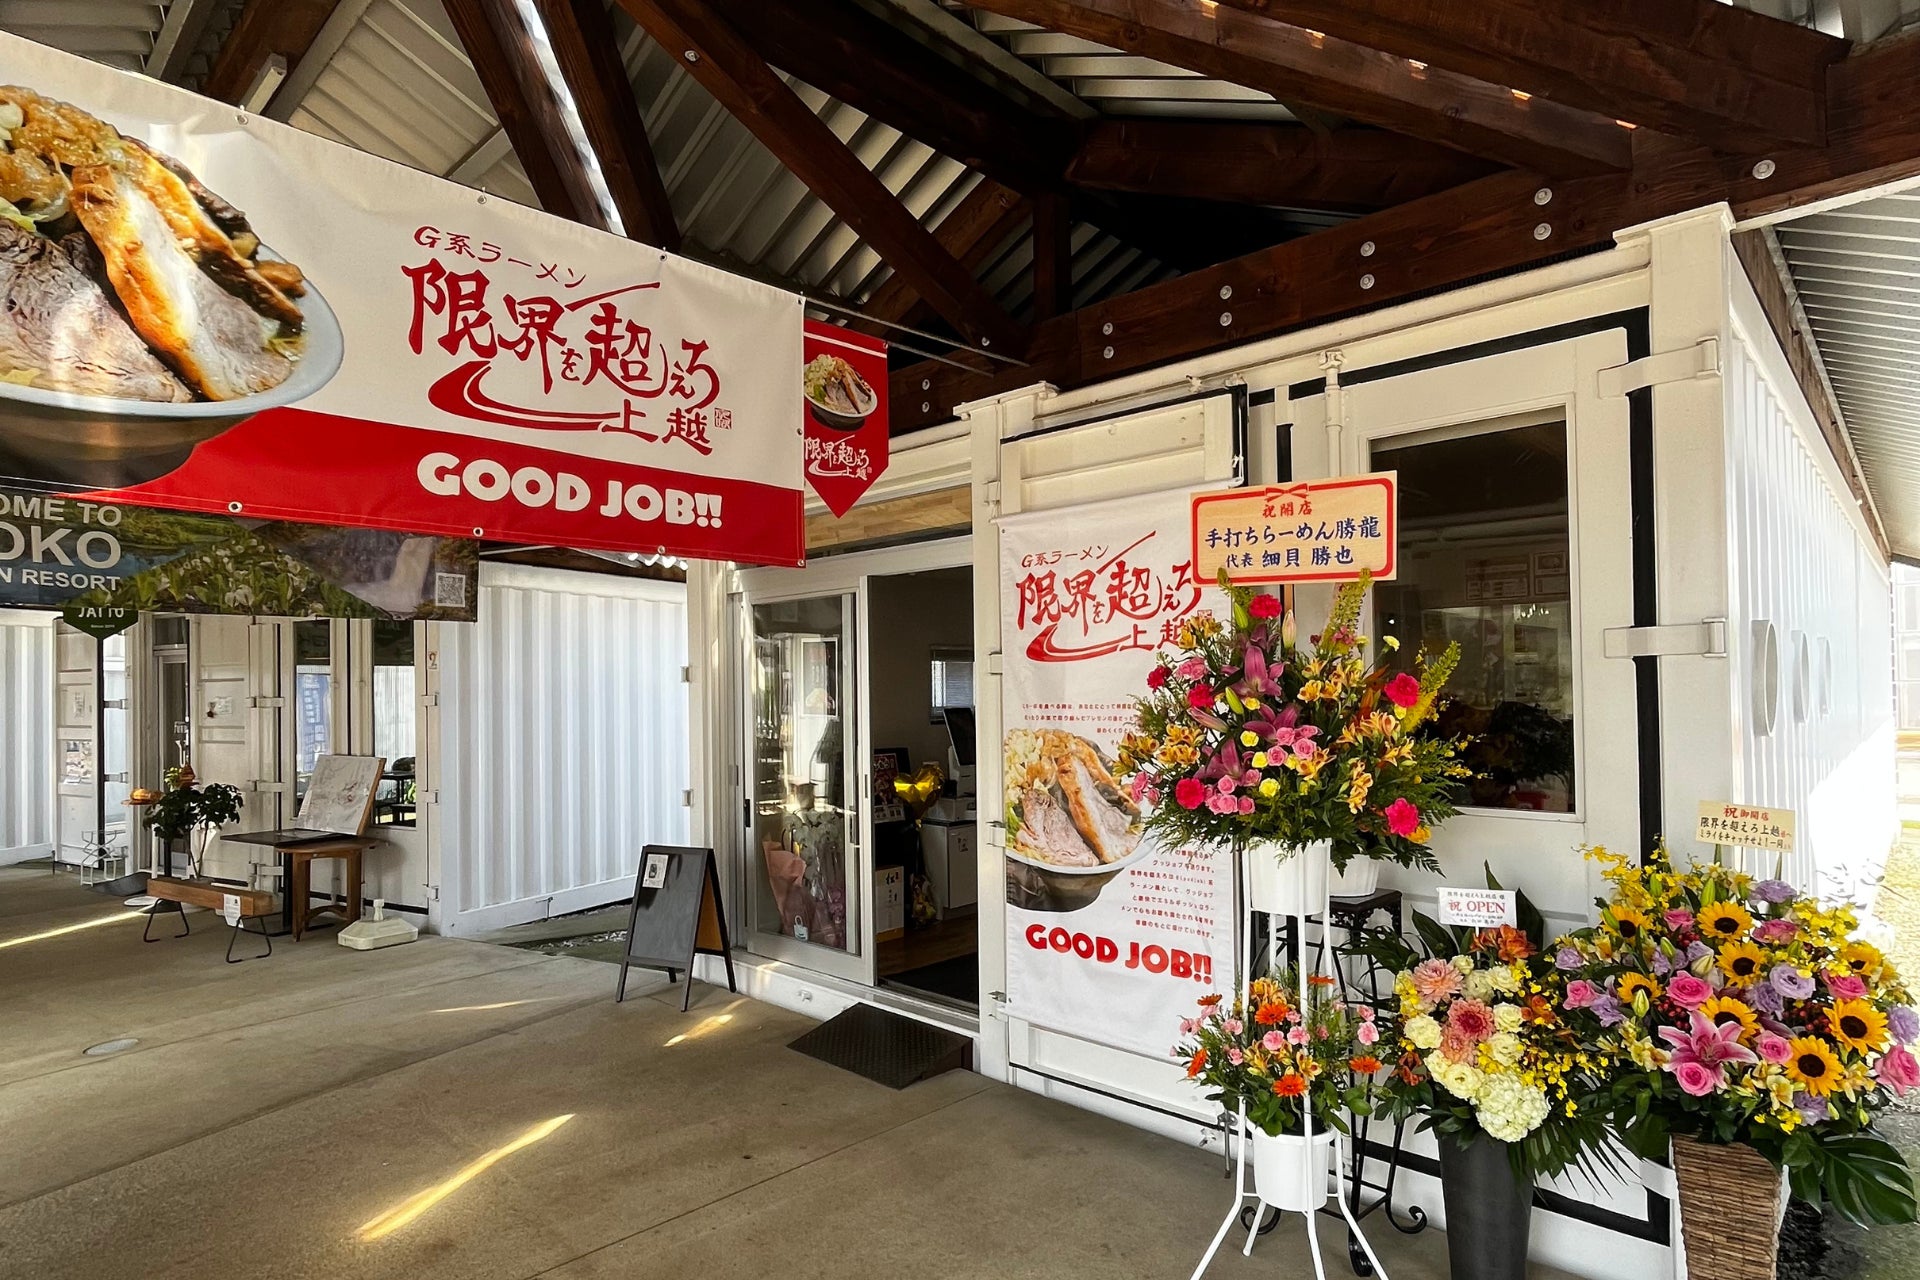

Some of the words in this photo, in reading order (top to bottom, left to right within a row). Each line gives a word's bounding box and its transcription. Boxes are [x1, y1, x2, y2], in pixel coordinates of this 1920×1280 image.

[413, 225, 587, 288] G系ラーメン
[401, 257, 720, 410] 限界を超えろ
[601, 399, 713, 456] 上越
[416, 451, 591, 512] GOOD
[600, 480, 723, 529] JOB!!
[77, 502, 122, 527] TO
[1262, 500, 1313, 518] 祝開店
[1205, 516, 1381, 549] 手打ちらーめん勝龍
[1021, 545, 1109, 568] G系ラーメン
[1226, 552, 1253, 568] 代表
[1262, 548, 1299, 568] 細貝
[1311, 545, 1354, 566] 勝也
[22, 568, 121, 591] RESORT
[1466, 901, 1506, 914] OPEN
[1025, 923, 1119, 964] GOOD
[1125, 942, 1212, 985] JOB!!
